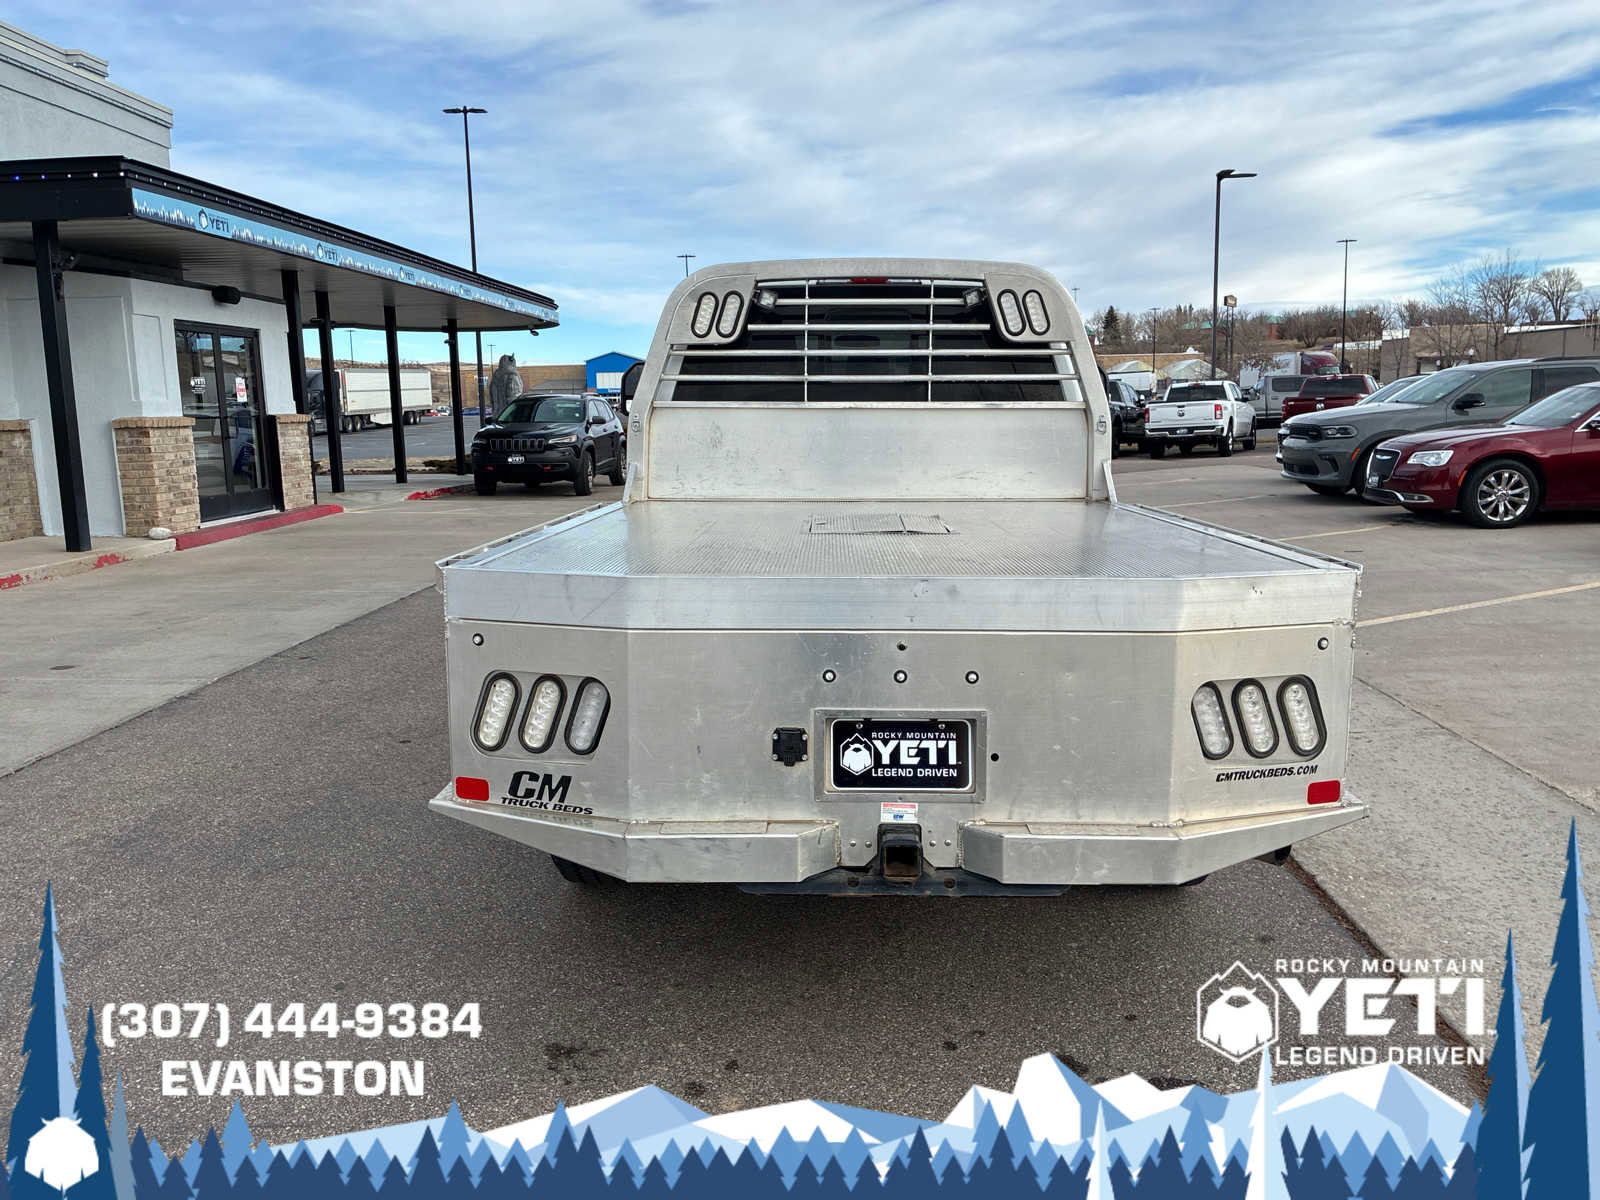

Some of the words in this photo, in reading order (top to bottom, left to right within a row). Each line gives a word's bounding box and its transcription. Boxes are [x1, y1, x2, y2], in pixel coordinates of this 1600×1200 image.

[209, 216, 230, 232] YETI
[324, 245, 338, 261] YETI
[872, 740, 957, 765] YETI
[871, 768, 914, 777] LEGEND
[917, 768, 958, 777] DRIVEN
[1215, 764, 1318, 782] CMTRUCKBEDS.COM
[507, 770, 573, 803] CM
[501, 796, 549, 810] TRUCK
[552, 802, 593, 815] BEDS
